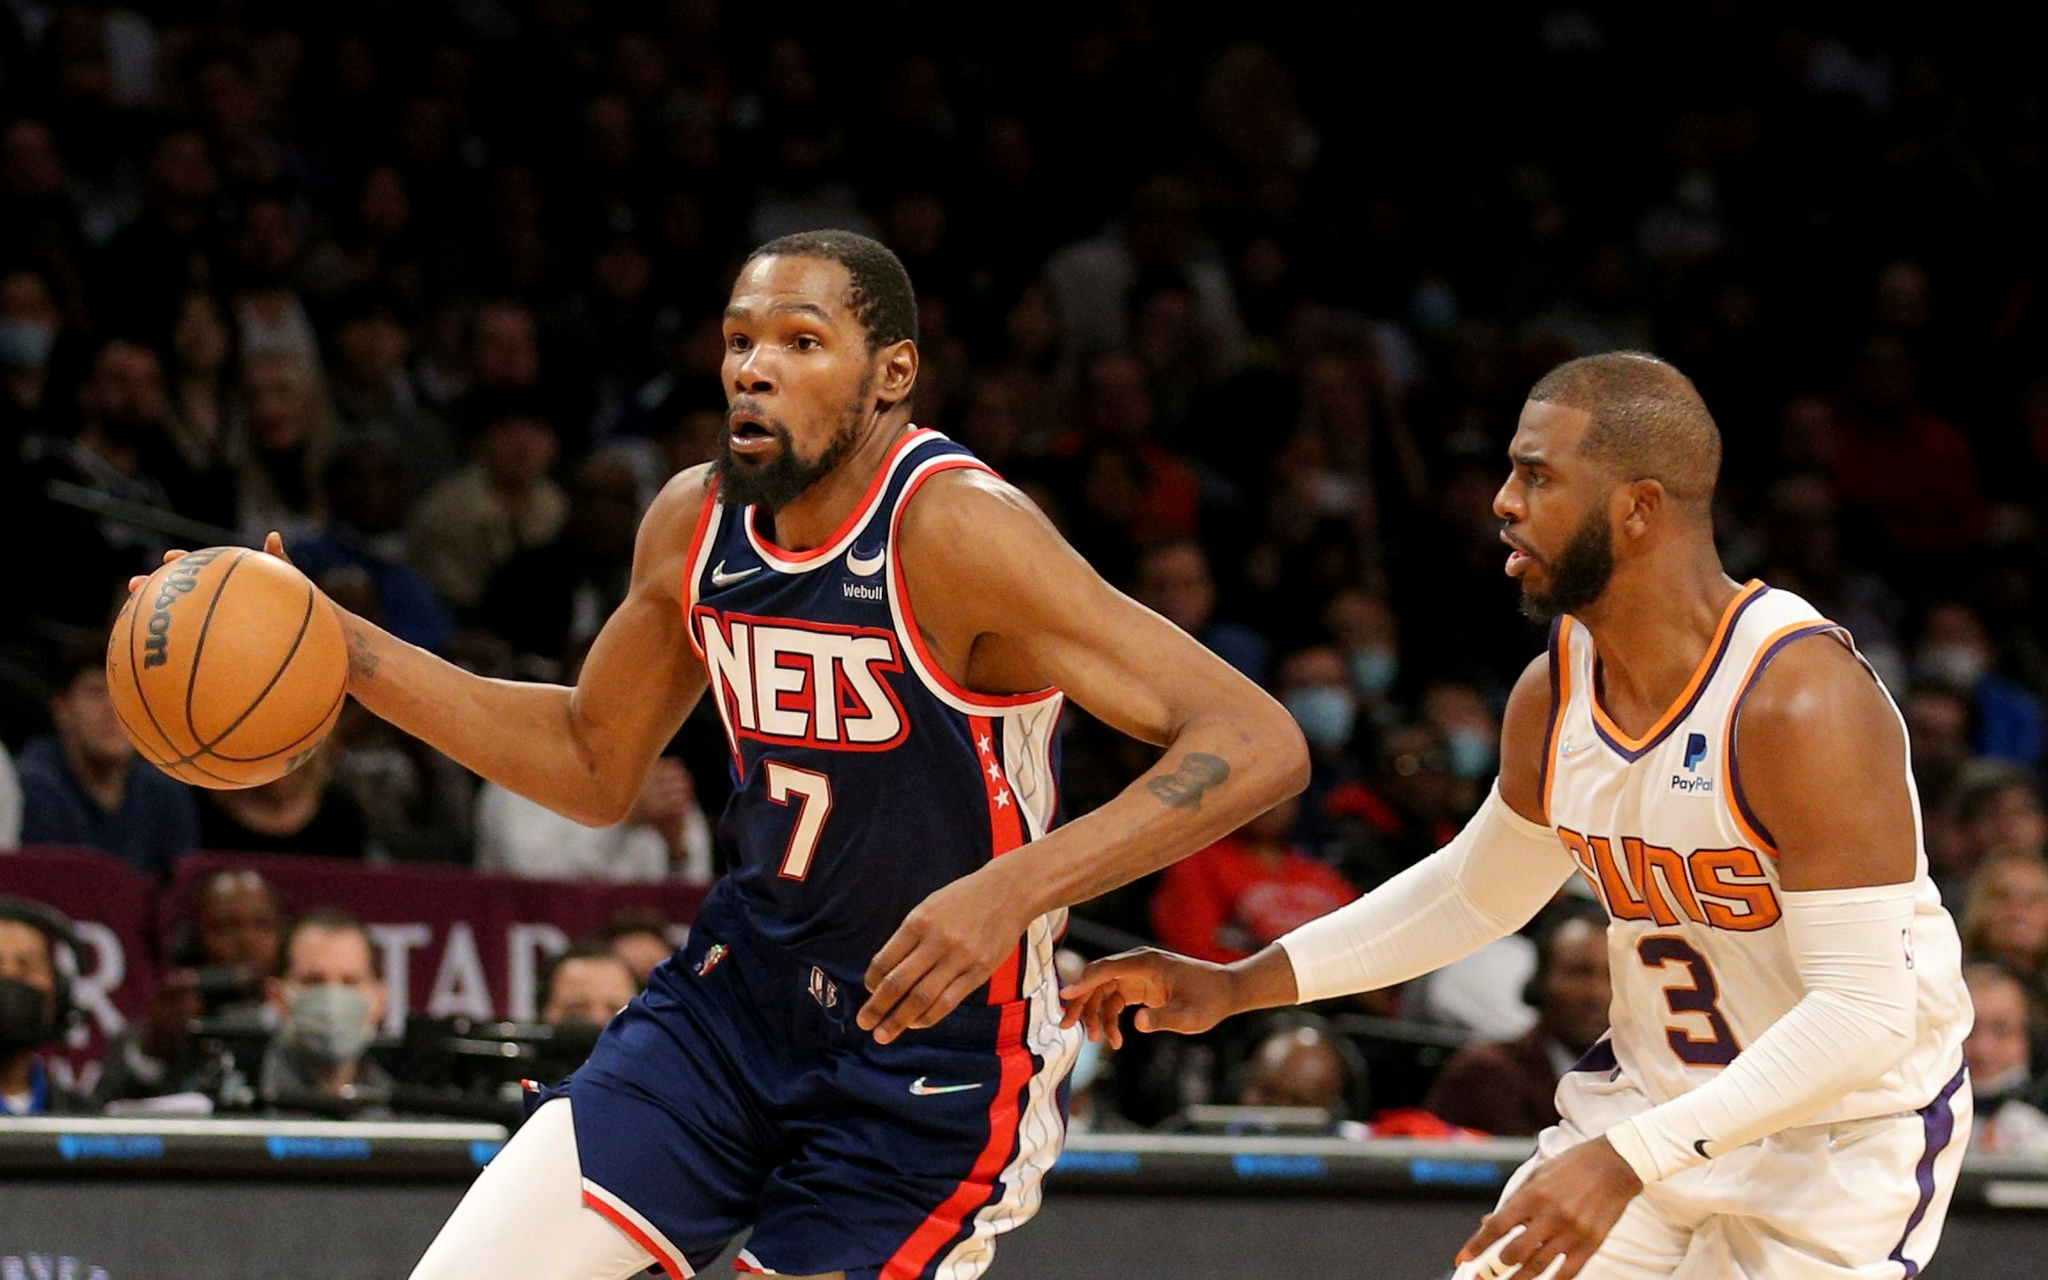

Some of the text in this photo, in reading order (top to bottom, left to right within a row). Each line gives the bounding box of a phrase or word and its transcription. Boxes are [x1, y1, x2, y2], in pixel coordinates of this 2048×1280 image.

[842, 582, 884, 601] Webull
[697, 607, 907, 760] NETS
[765, 760, 833, 881] 7
[1670, 774, 1714, 793] PayPal
[1636, 933, 1744, 1069] 3
